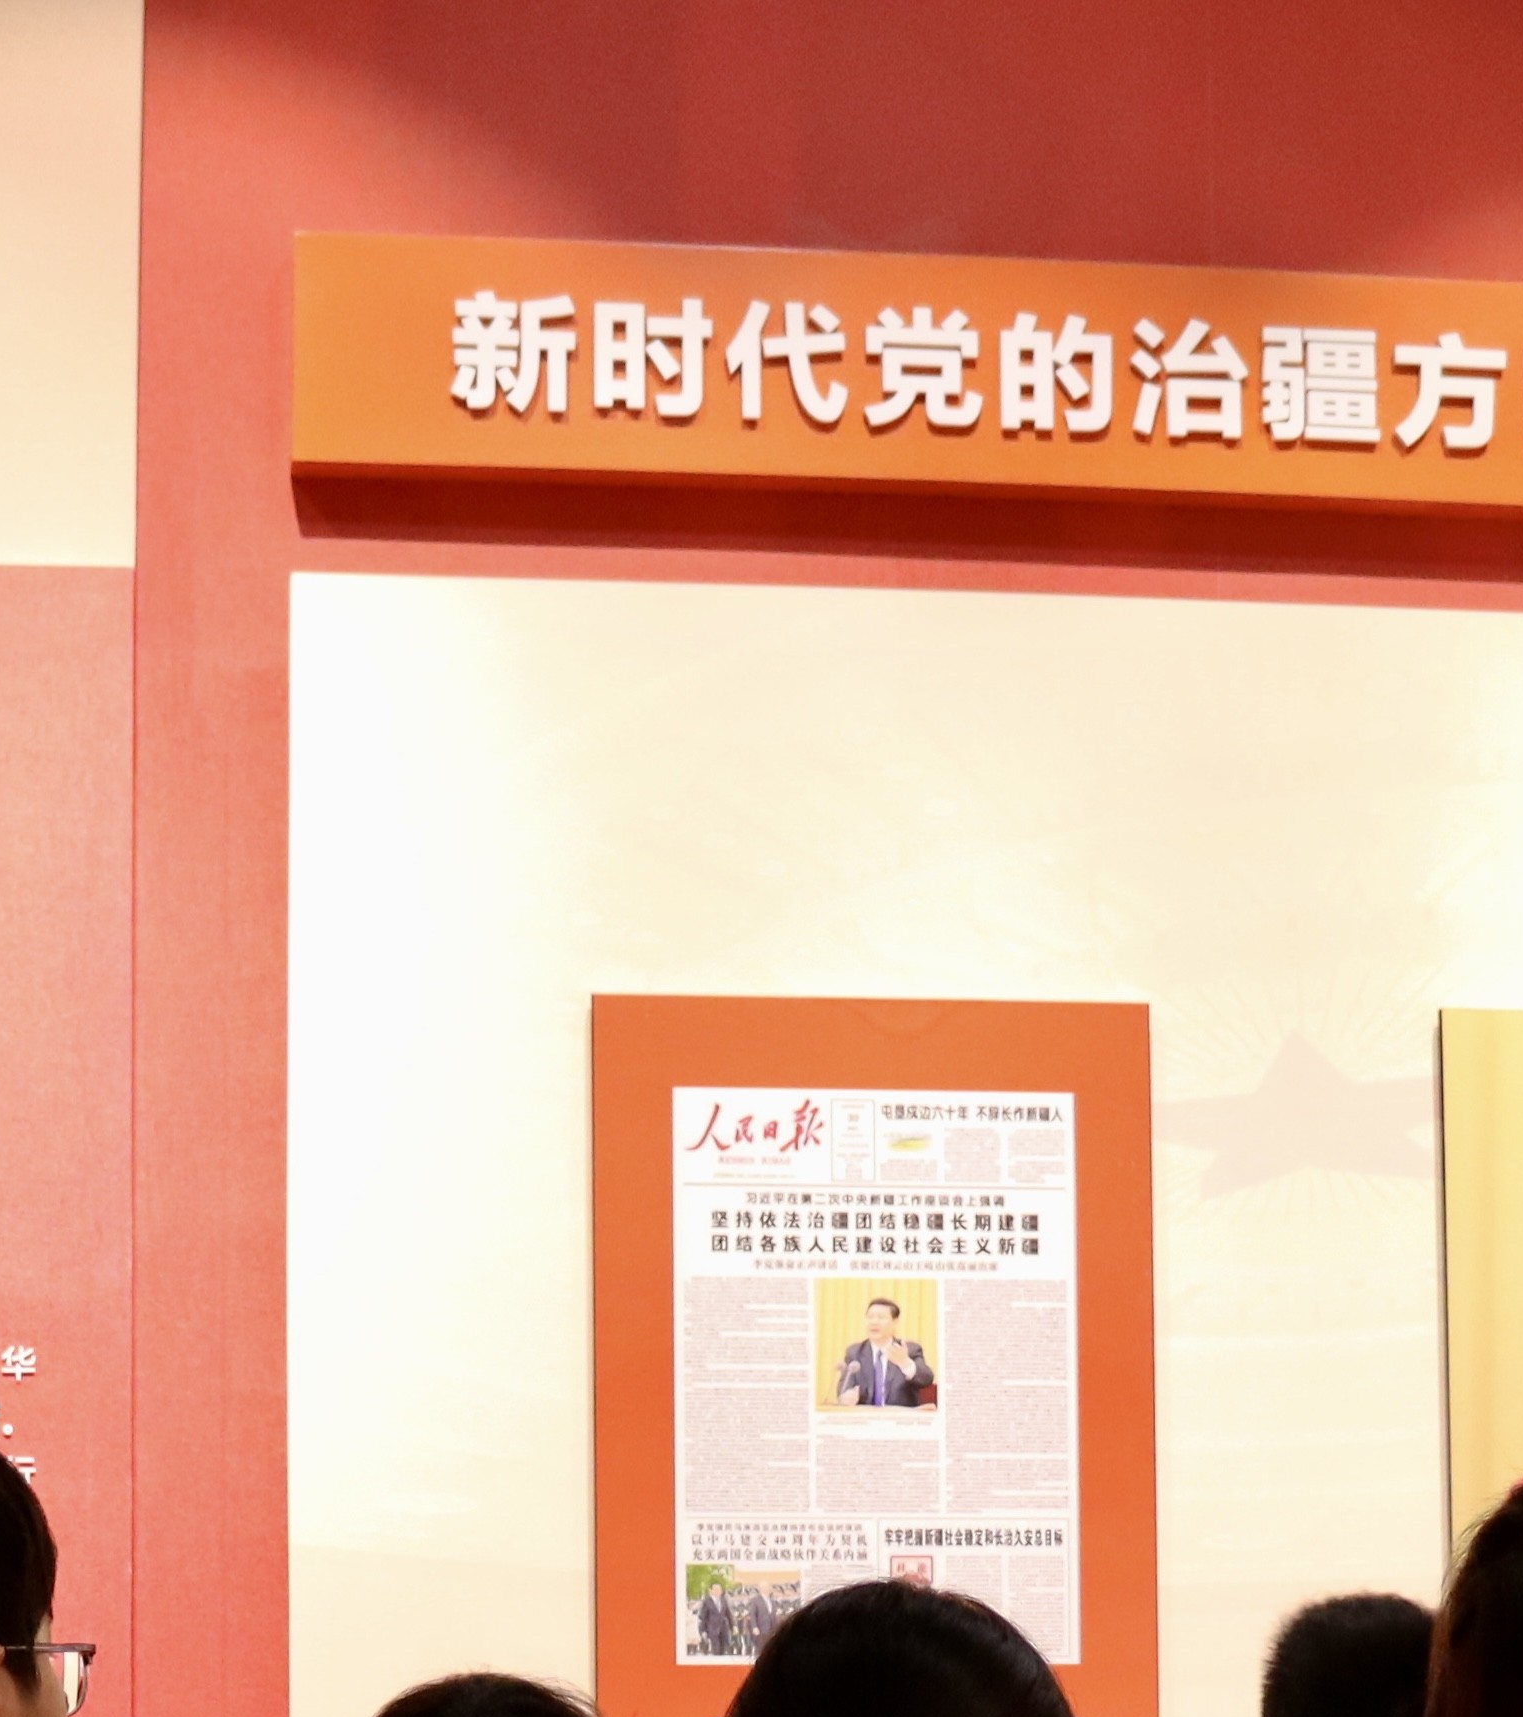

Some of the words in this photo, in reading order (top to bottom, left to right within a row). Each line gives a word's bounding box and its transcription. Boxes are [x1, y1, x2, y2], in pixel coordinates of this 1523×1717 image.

[685, 1098, 824, 1152] 人民日报
[711, 1210, 1040, 1232] 坚持依法治疆团结稳疆长期建疆
[711, 1234, 1040, 1256] 团结各族人民建设社会主义新疆
